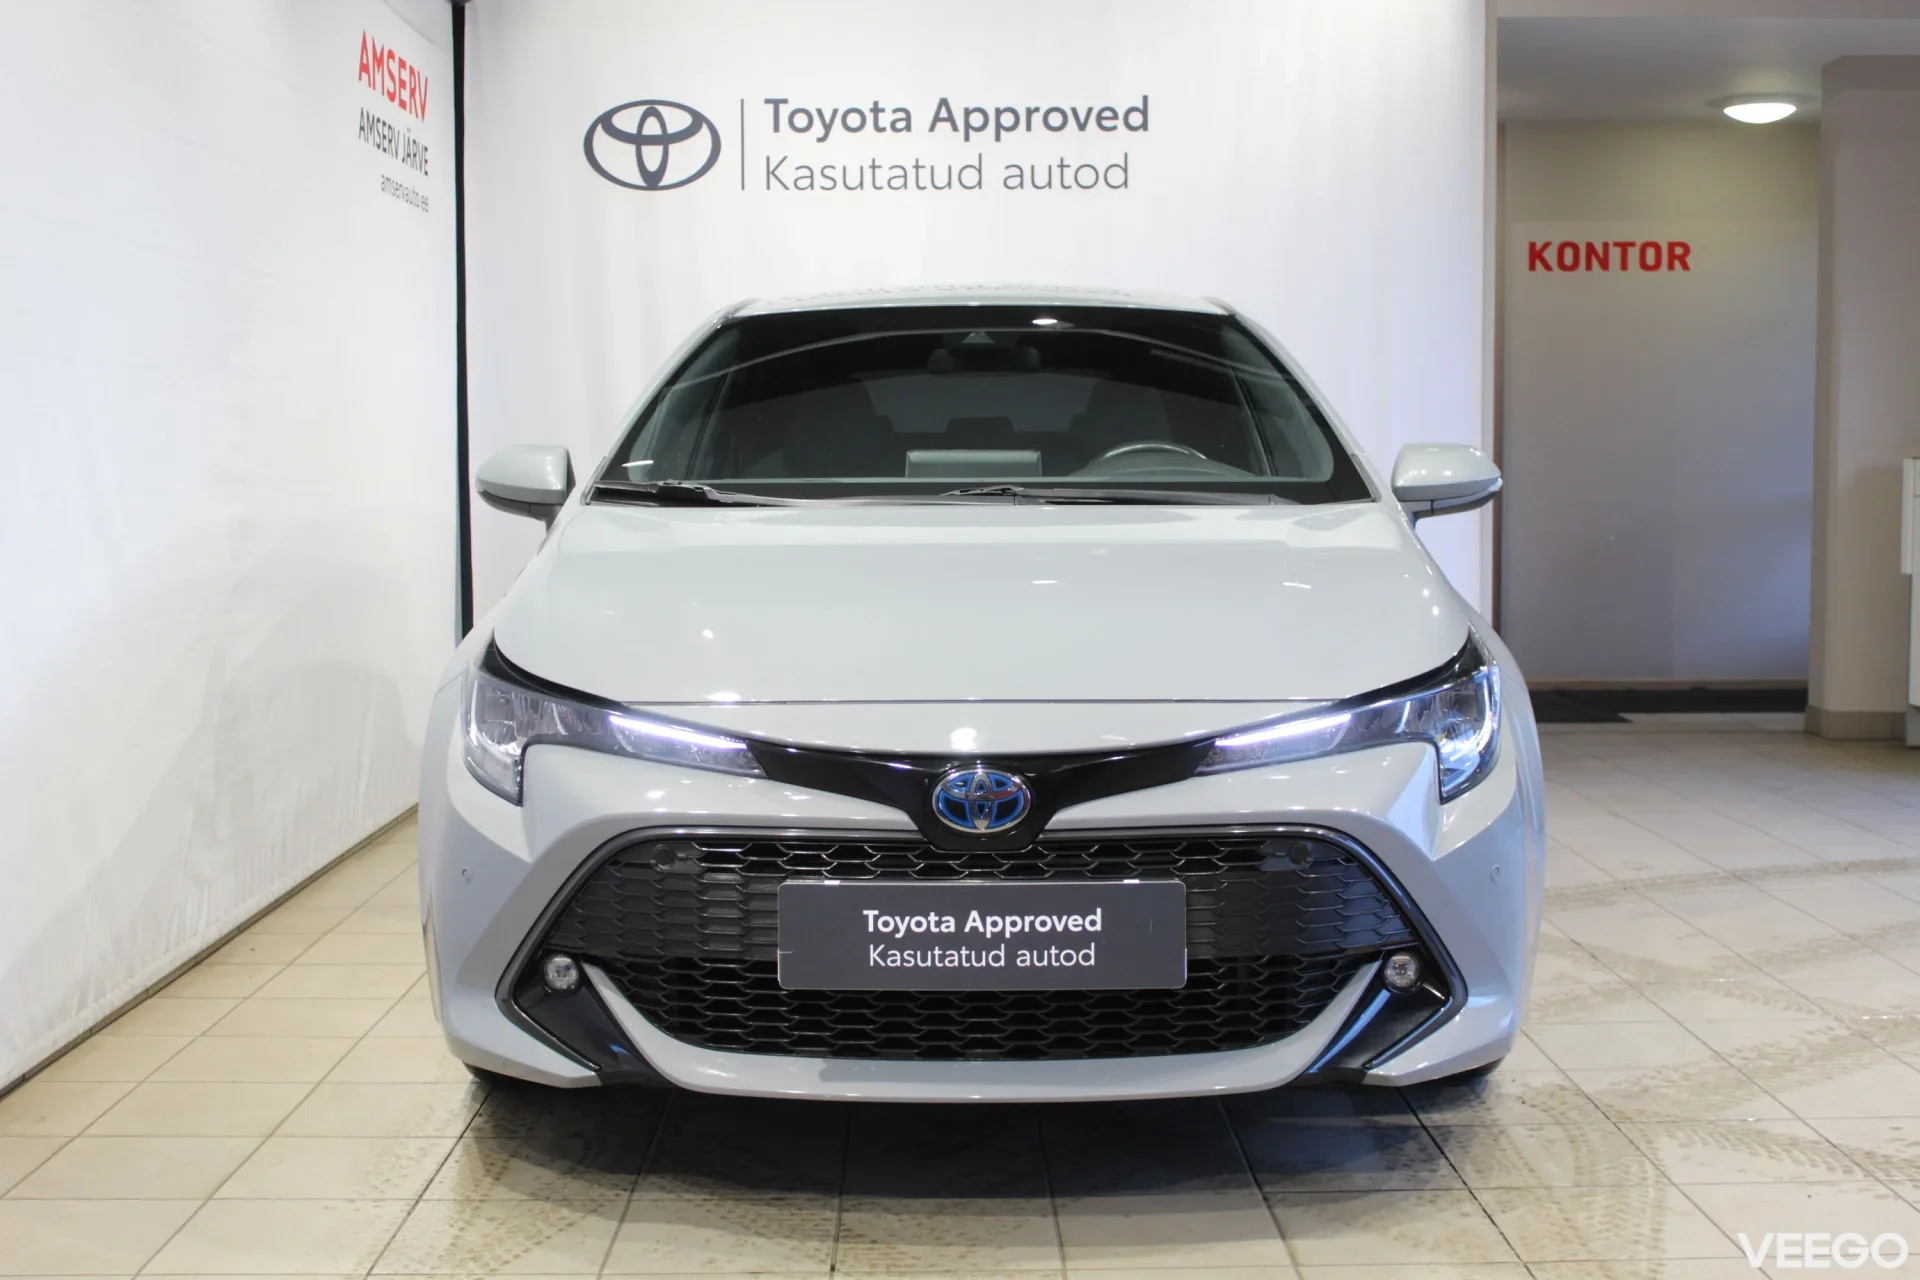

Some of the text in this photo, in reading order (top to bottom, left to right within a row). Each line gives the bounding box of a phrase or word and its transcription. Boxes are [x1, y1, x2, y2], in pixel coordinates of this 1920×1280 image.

[358, 29, 428, 123] AMSERV
[764, 95, 1150, 142] Toyota Approved
[358, 107, 429, 176] AMSERV JÄRVE
[765, 153, 1129, 190] Kasutatud autod
[1528, 240, 1691, 272] KONTOR
[863, 908, 1102, 937] Toyota Approved
[869, 943, 1095, 967] Kasutatud autod
